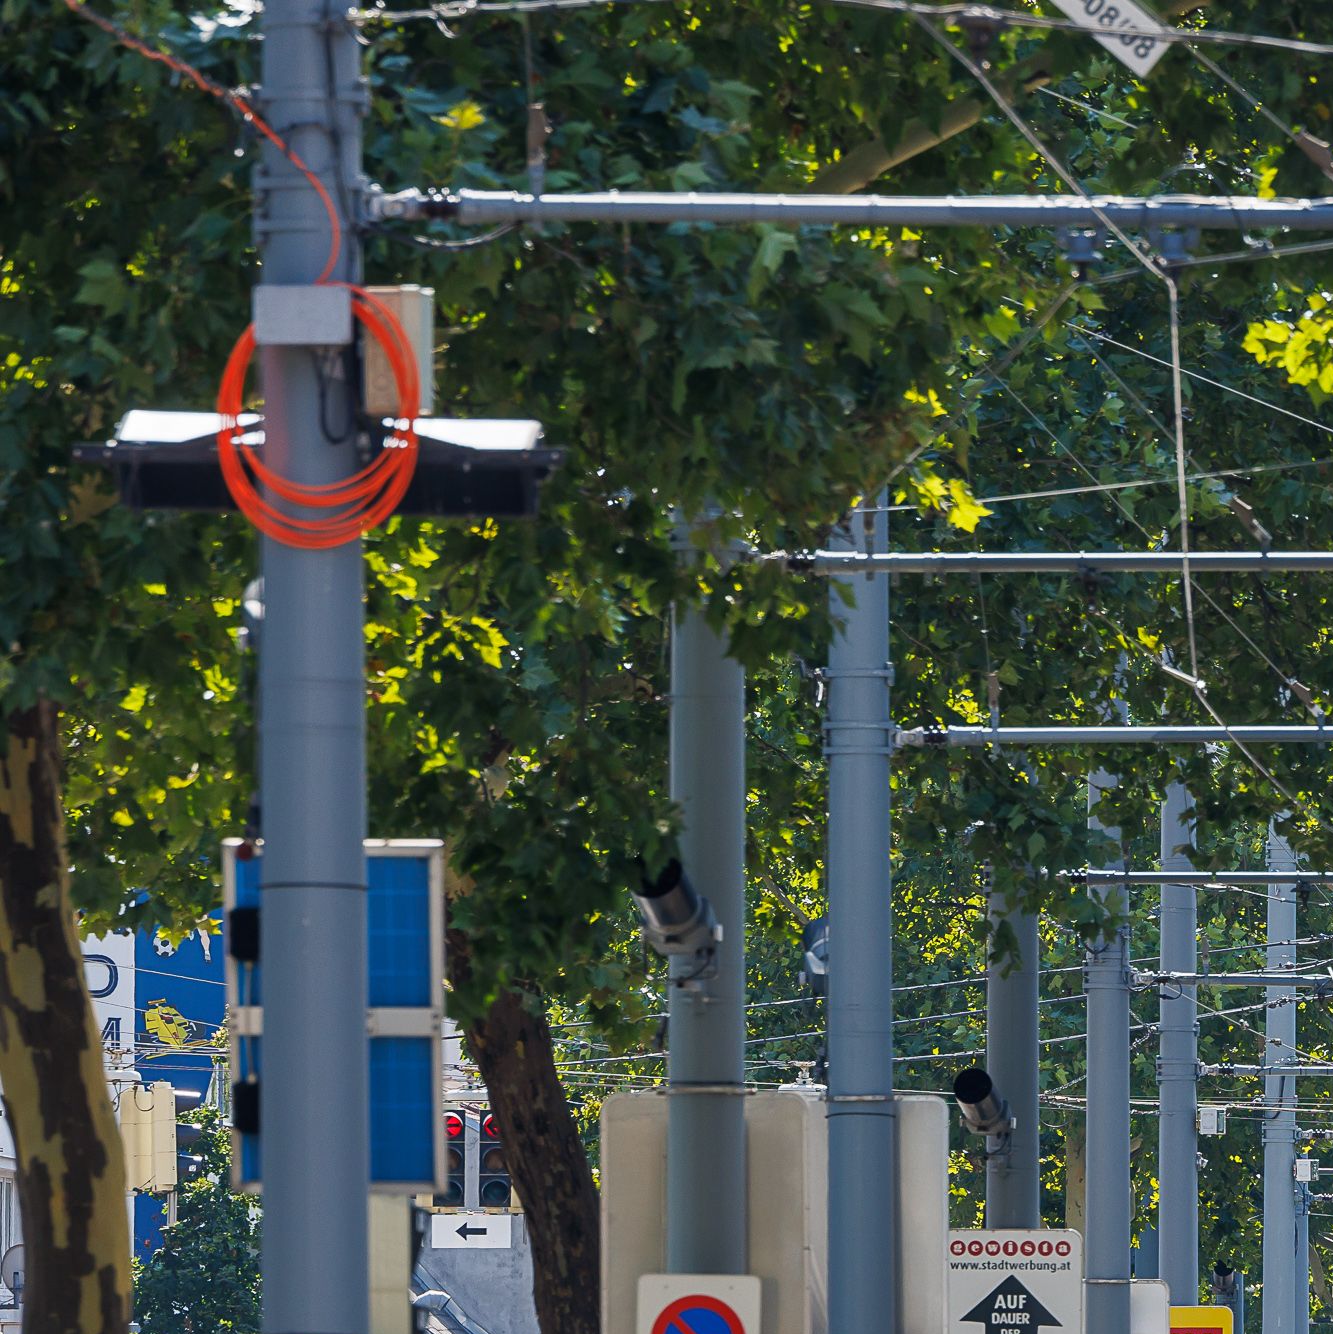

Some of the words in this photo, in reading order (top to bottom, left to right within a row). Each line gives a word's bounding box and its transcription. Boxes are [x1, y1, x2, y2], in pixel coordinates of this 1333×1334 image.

[950, 1240, 1072, 1257] gewista
[950, 1260, 1071, 1273] www.stadtwerbung.at
[994, 1294, 1027, 1309] AUF
[991, 1312, 1030, 1324] DAUER
